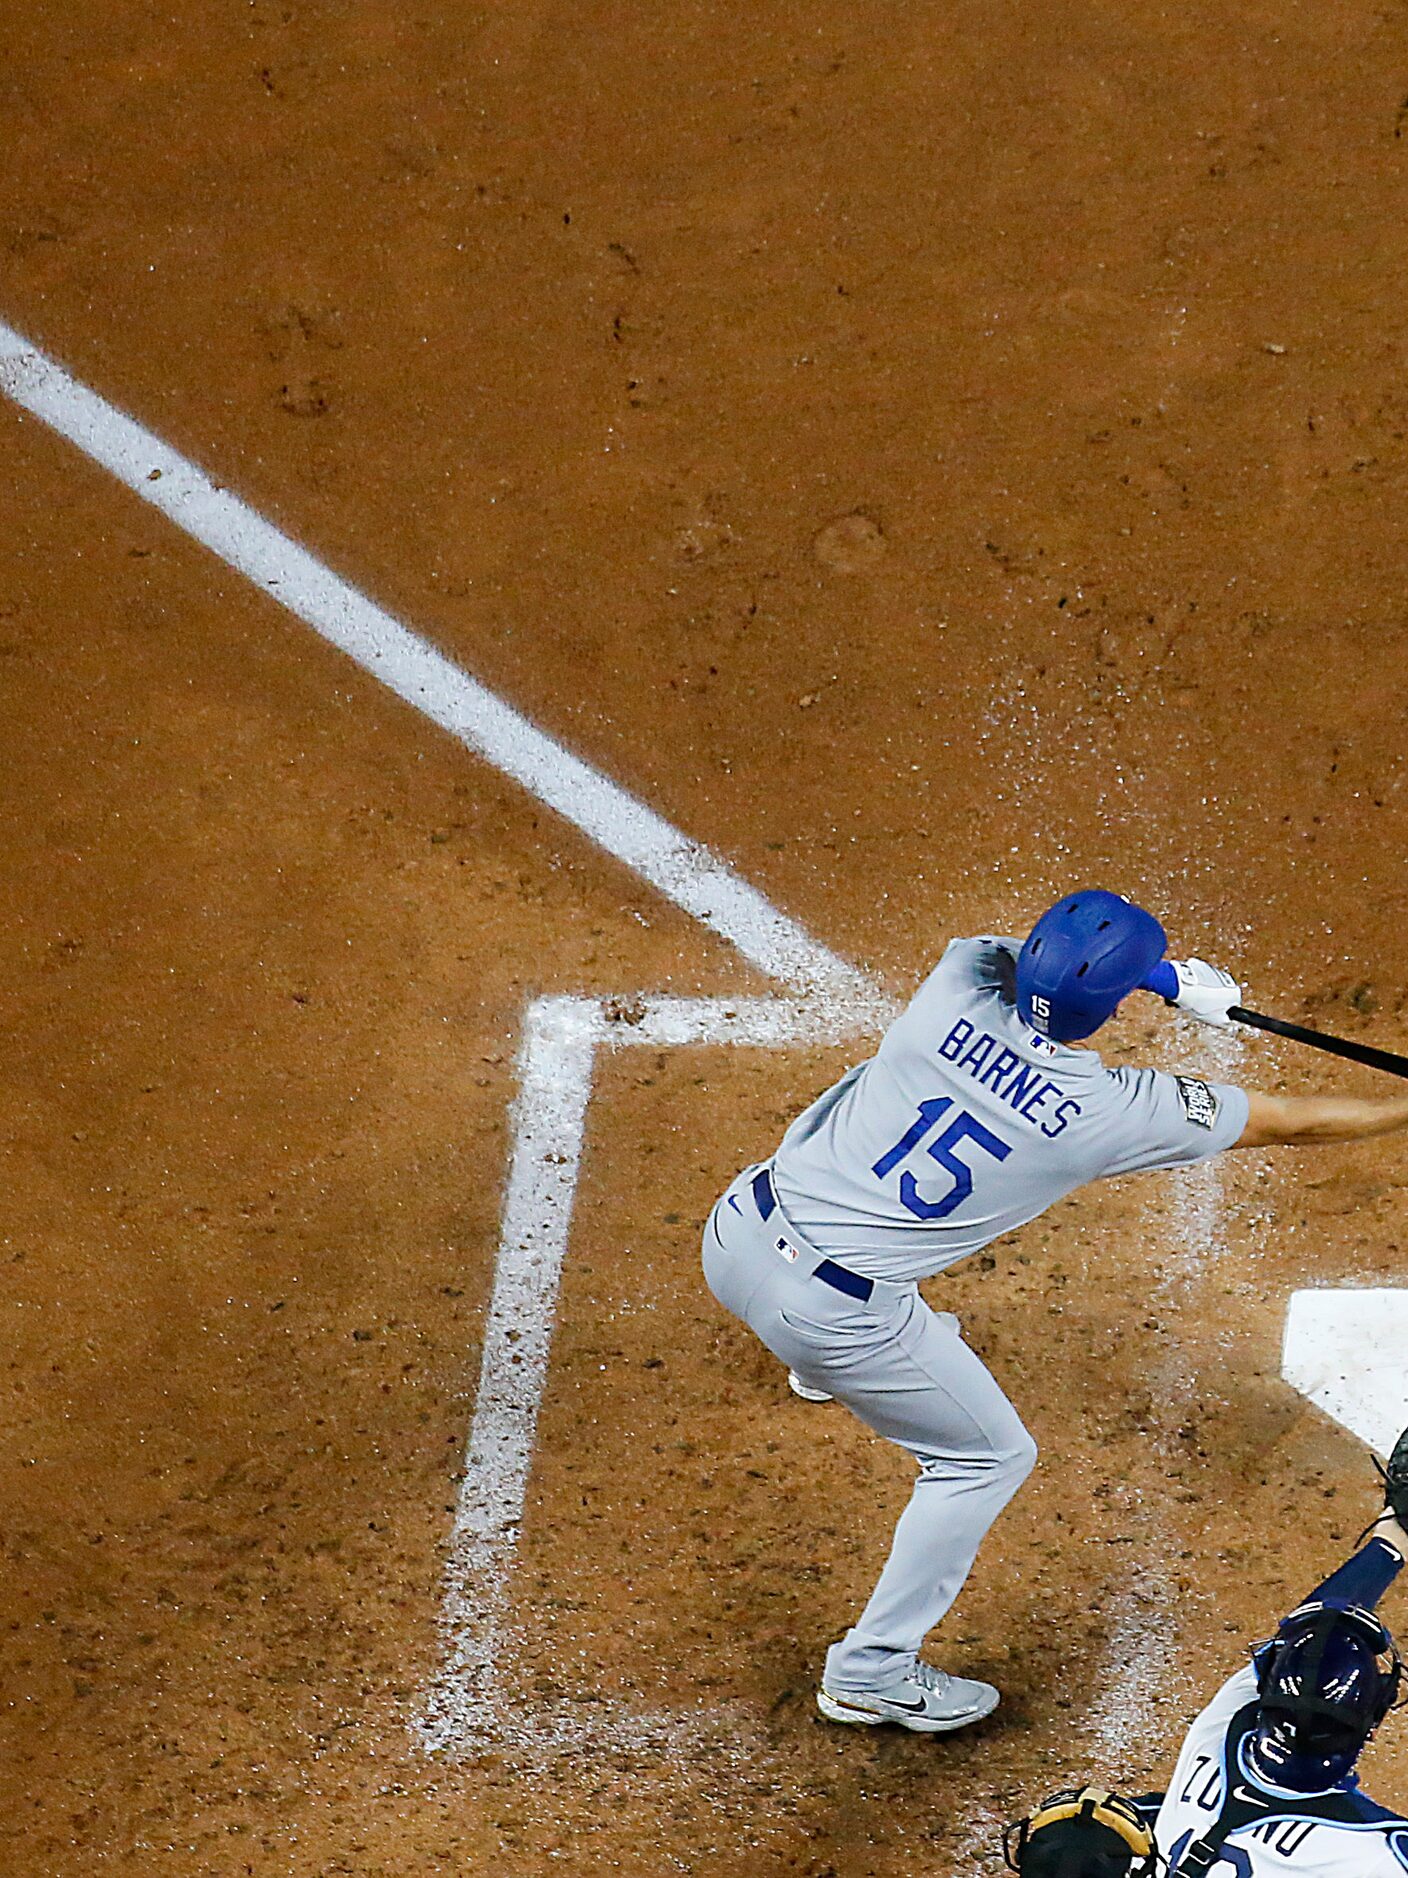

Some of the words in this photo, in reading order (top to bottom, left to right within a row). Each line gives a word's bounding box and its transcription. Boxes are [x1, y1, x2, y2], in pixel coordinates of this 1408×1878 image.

[1031, 994, 1051, 1017] 15
[937, 1017, 1082, 1138] BARNES
[1180, 1077, 1202, 1121] WORLD
[1194, 1081, 1212, 1127] SERIES
[871, 1096, 1014, 1220] 15
